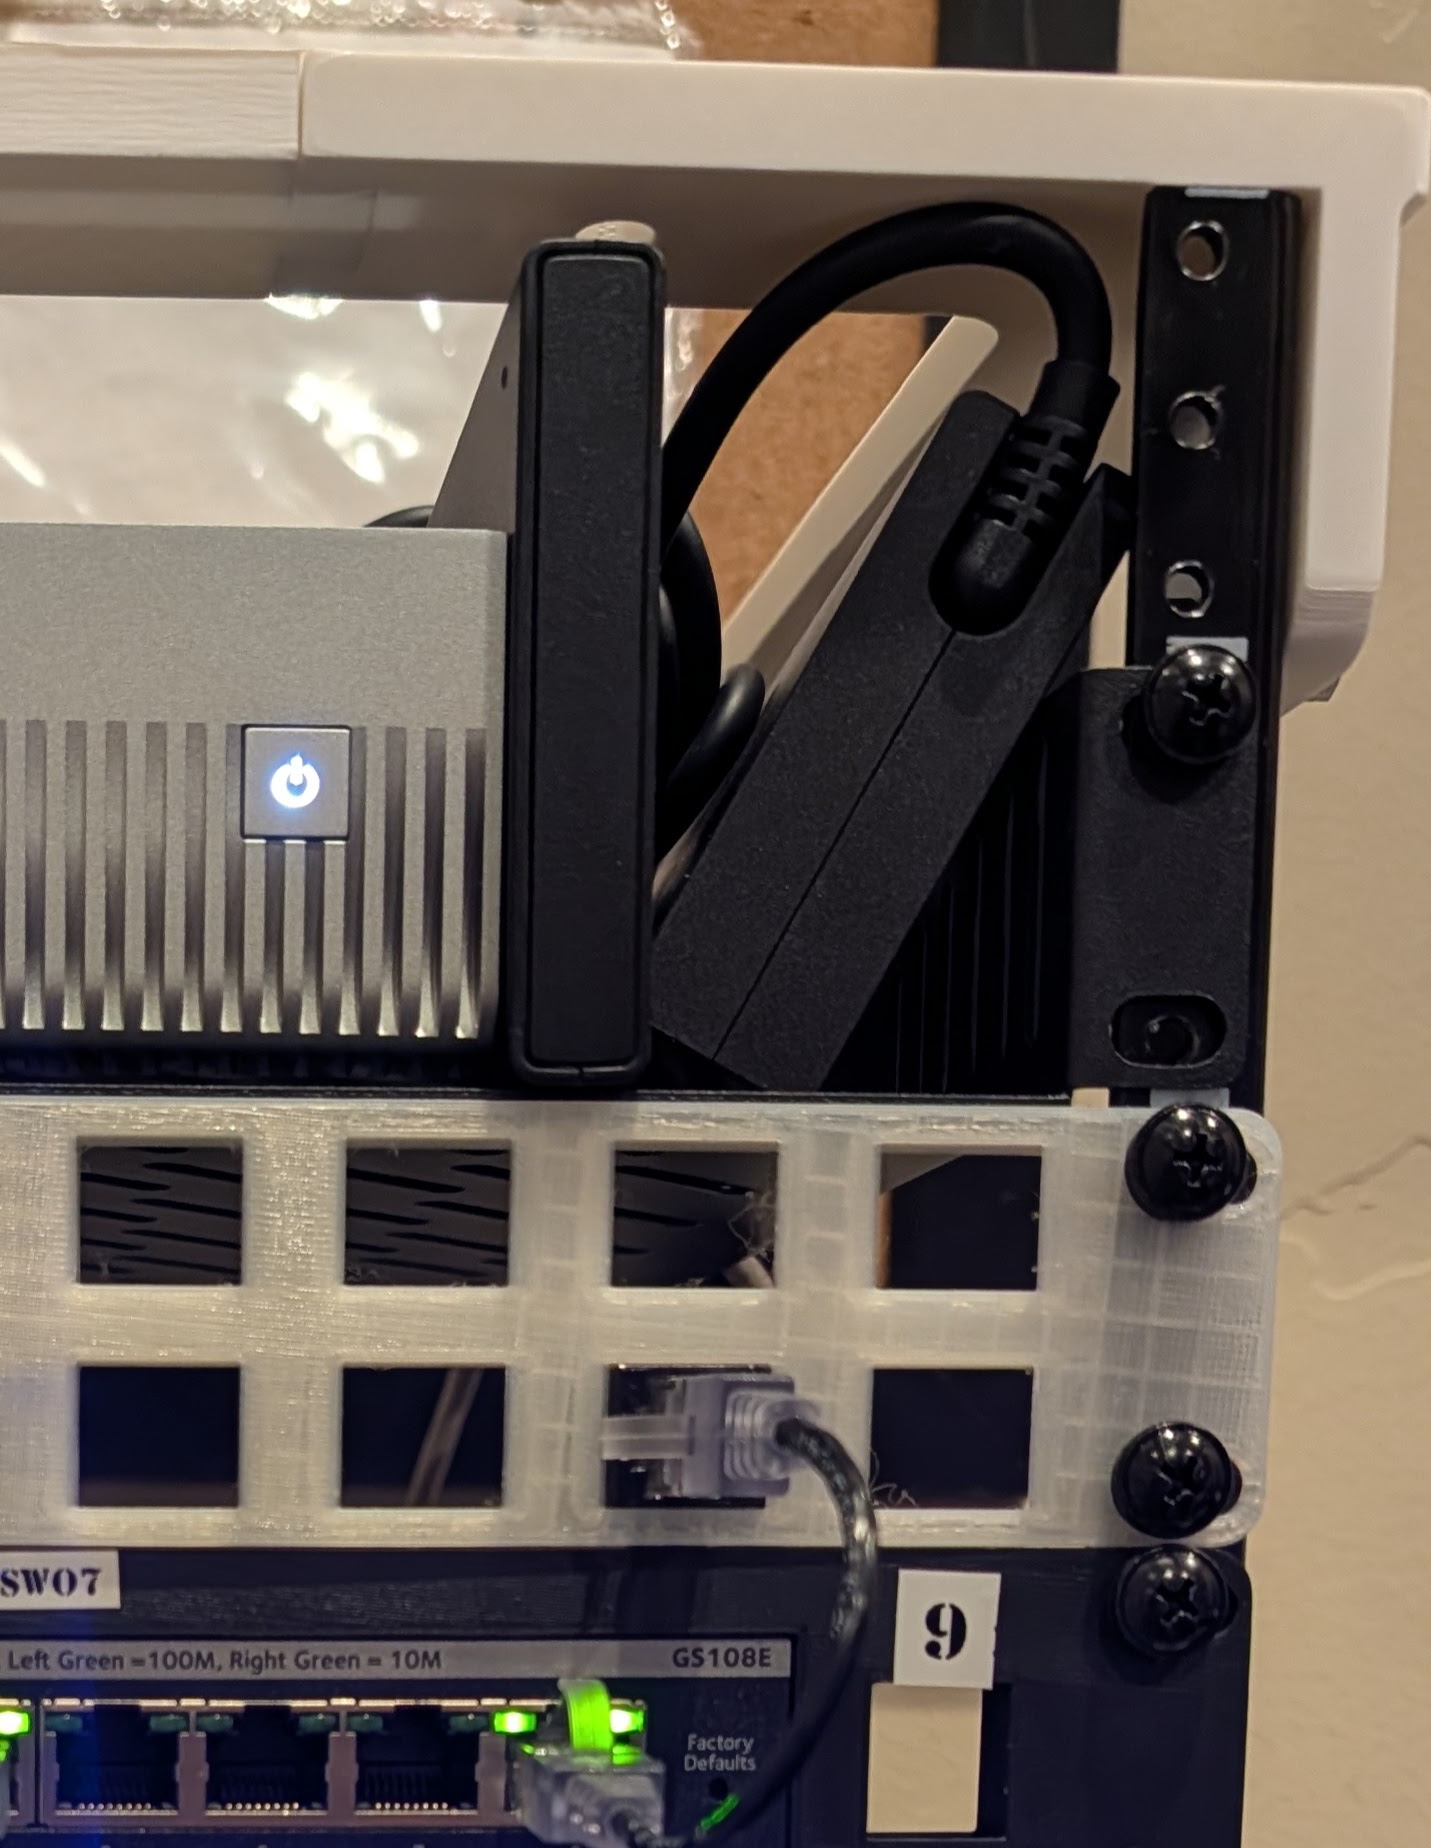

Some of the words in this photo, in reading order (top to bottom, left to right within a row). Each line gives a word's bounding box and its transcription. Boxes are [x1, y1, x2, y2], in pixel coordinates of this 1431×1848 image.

[924, 1602, 968, 1660] 9
[8, 1650, 51, 1671] Left
[56, 1650, 125, 1672] Green
[229, 1649, 286, 1676] Right
[294, 1650, 361, 1672] Green
[391, 1650, 442, 1671] 10M
[672, 1647, 772, 1669] GS108E
[686, 1734, 755, 1755] Factory
[683, 1753, 757, 1773] Defaults
